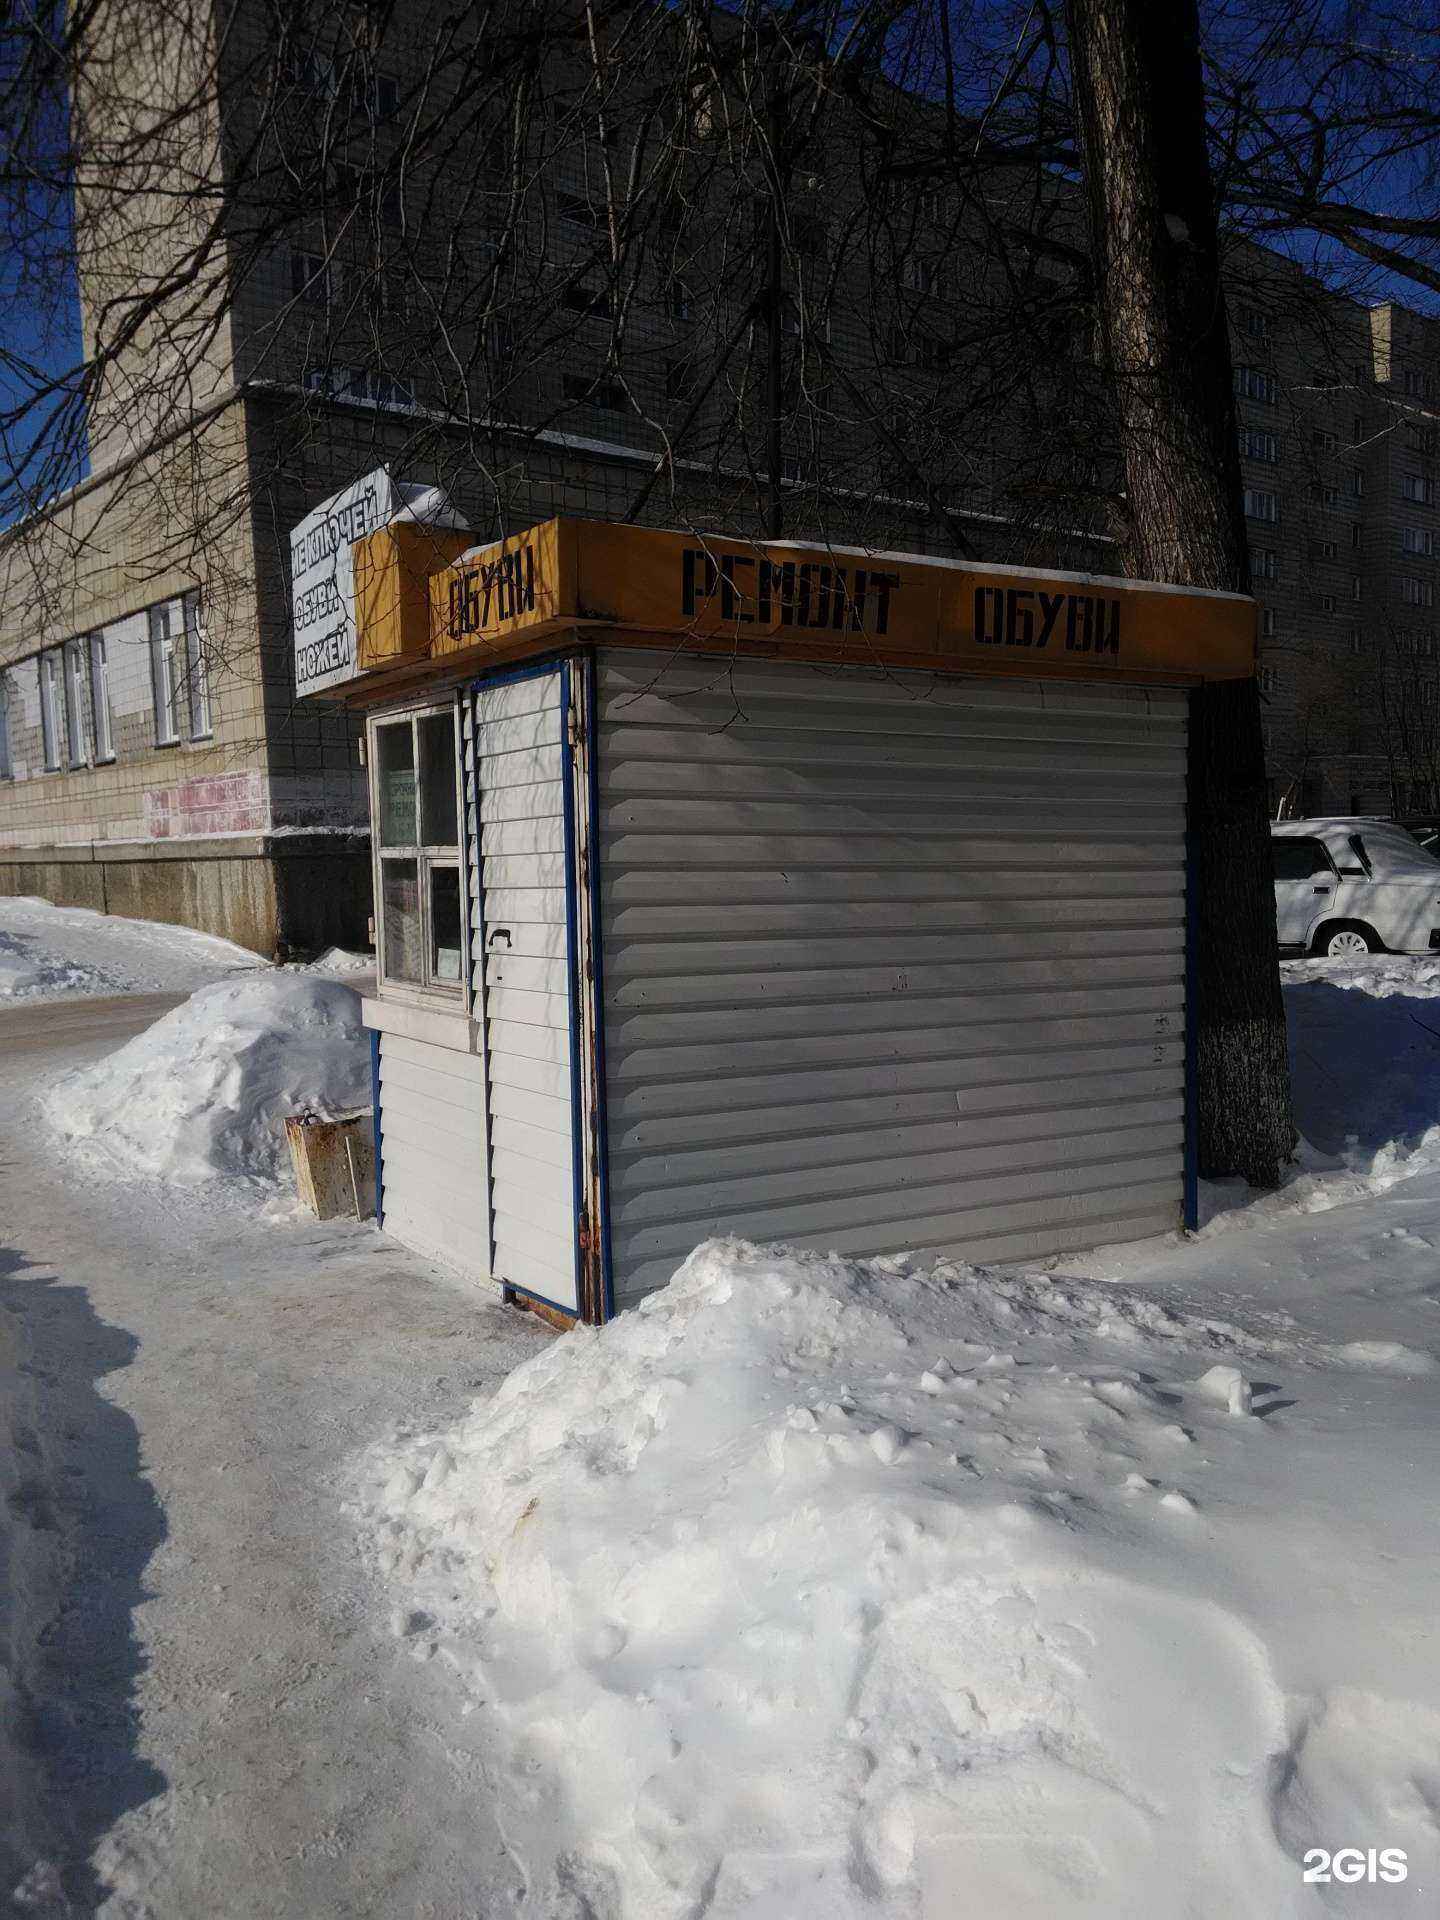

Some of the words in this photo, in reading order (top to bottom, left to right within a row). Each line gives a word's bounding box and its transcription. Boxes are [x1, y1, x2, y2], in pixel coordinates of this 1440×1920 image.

[307, 485, 382, 570] КЛЮЧЕЙ
[448, 544, 535, 641] ОБУВИ
[681, 549, 898, 635] РЕМОНТ
[973, 586, 1121, 654] ОБУВИ
[296, 622, 351, 684] НОЖЕЙ
